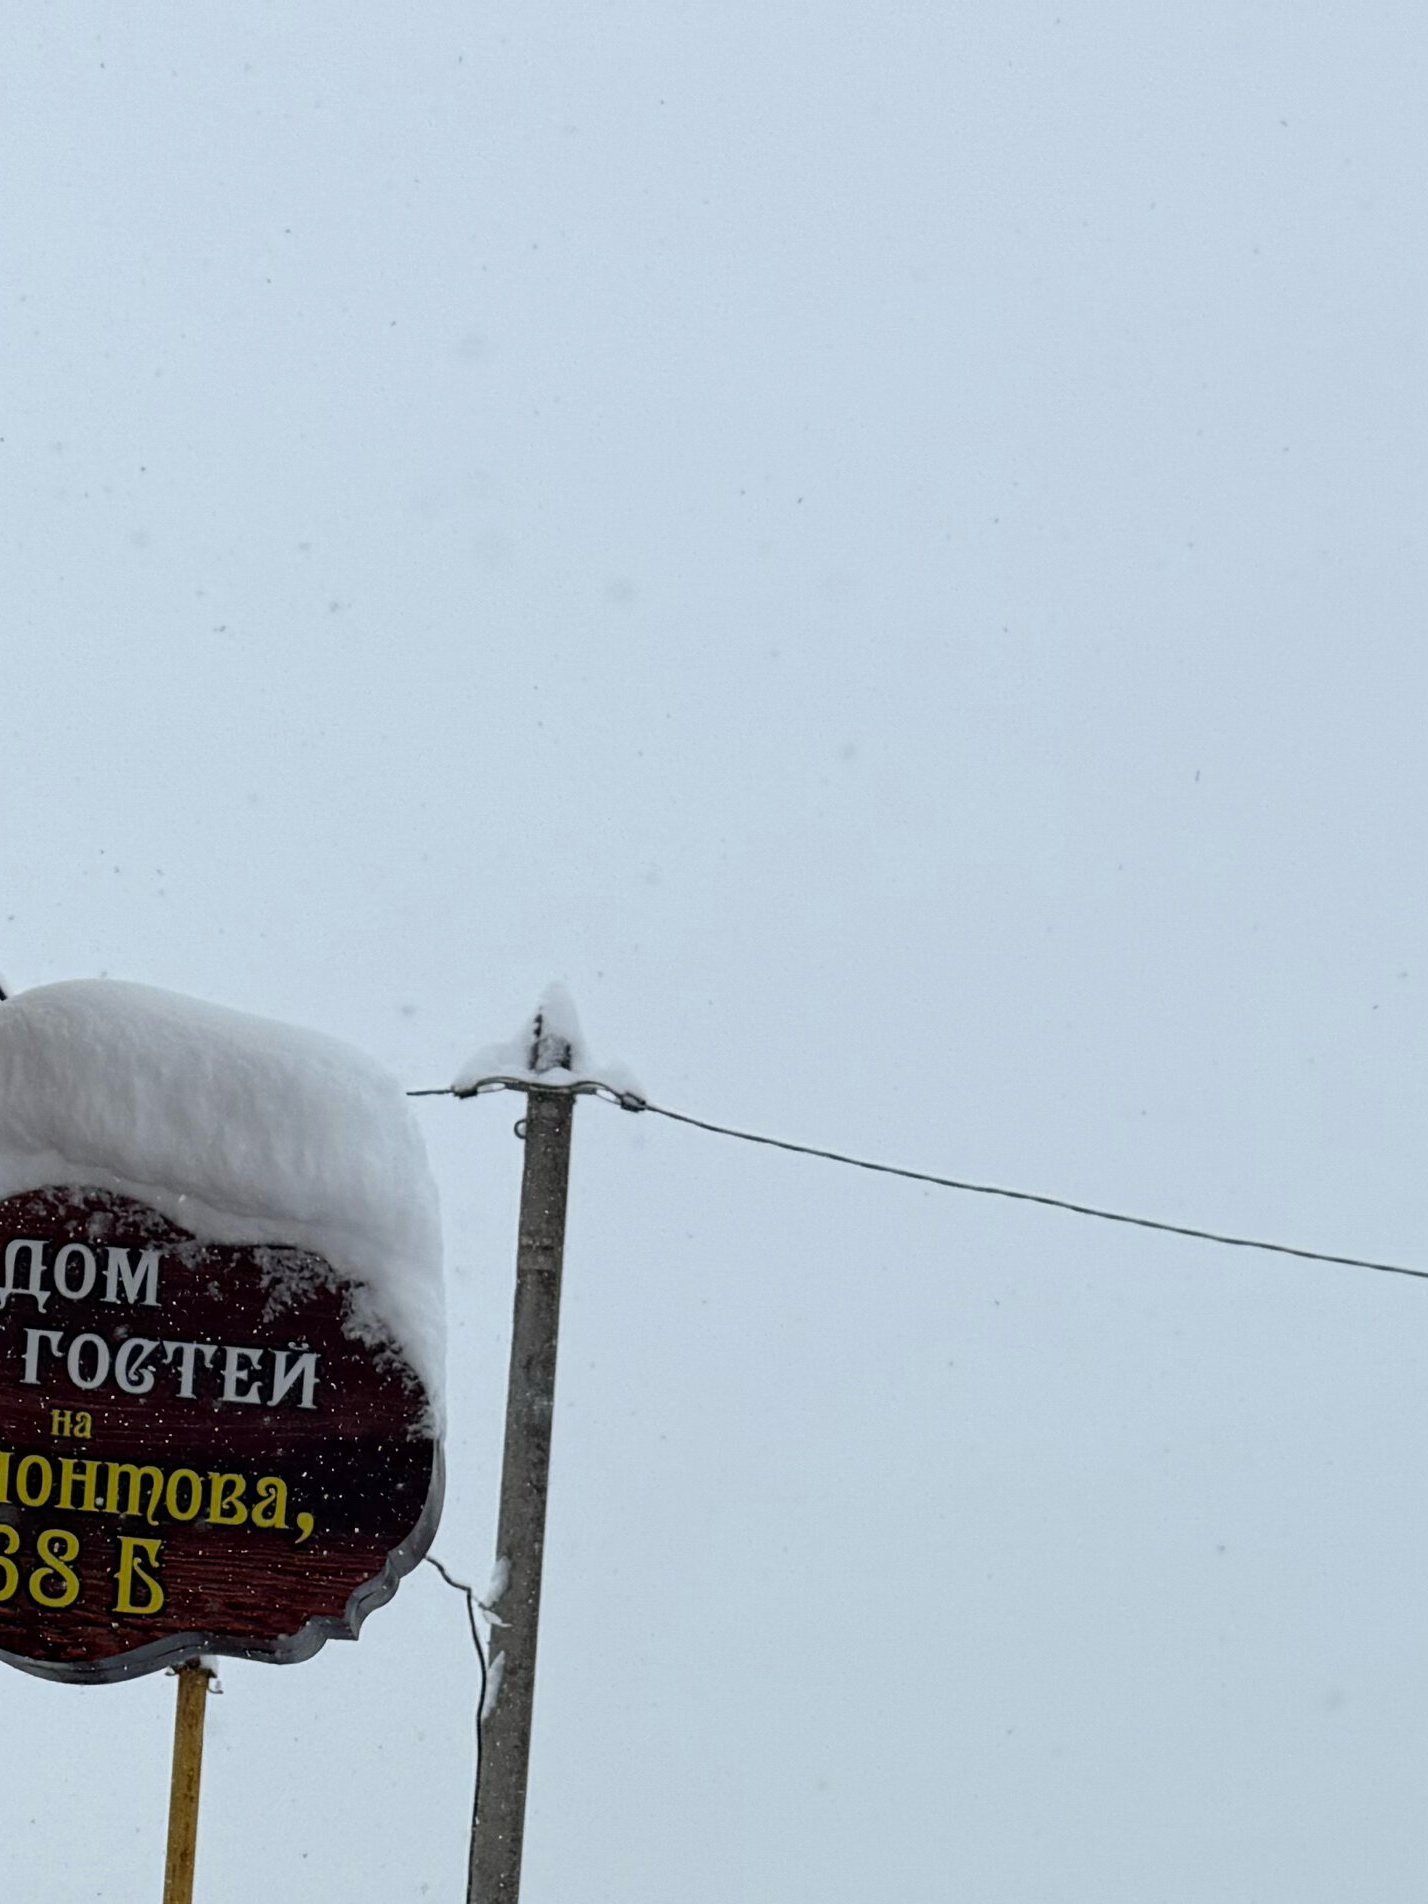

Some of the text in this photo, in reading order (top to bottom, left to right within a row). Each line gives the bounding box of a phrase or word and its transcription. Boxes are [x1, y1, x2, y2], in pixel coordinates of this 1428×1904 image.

[21, 1328, 321, 1409] ГОСТЕЙ
[50, 1409, 92, 1439] на
[114, 1536, 164, 1614] Б
